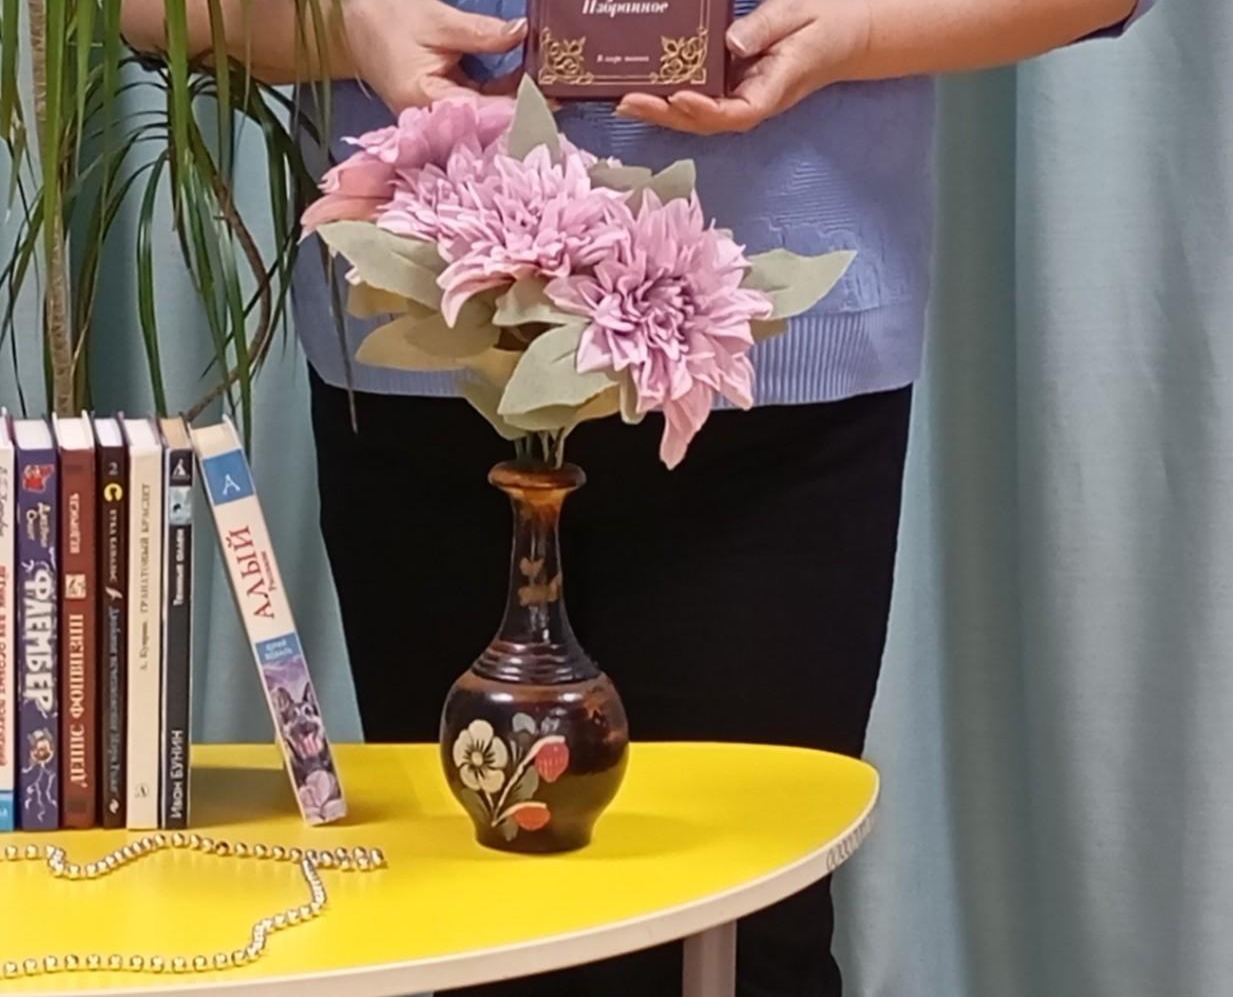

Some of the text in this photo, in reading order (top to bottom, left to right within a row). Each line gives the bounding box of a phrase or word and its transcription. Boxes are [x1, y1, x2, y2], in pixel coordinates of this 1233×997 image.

[140, 483, 150, 533] БРАСЛЕТ
[139, 537, 149, 614] ГРАНАТОВЫЙ
[225, 525, 275, 619] АЛЫЙ
[24, 568, 54, 714] ФЛЕМБЕР
[69, 614, 88, 788] ДЕНИС ФОНВИЗИН
[170, 729, 184, 819] Иван БУНИН
